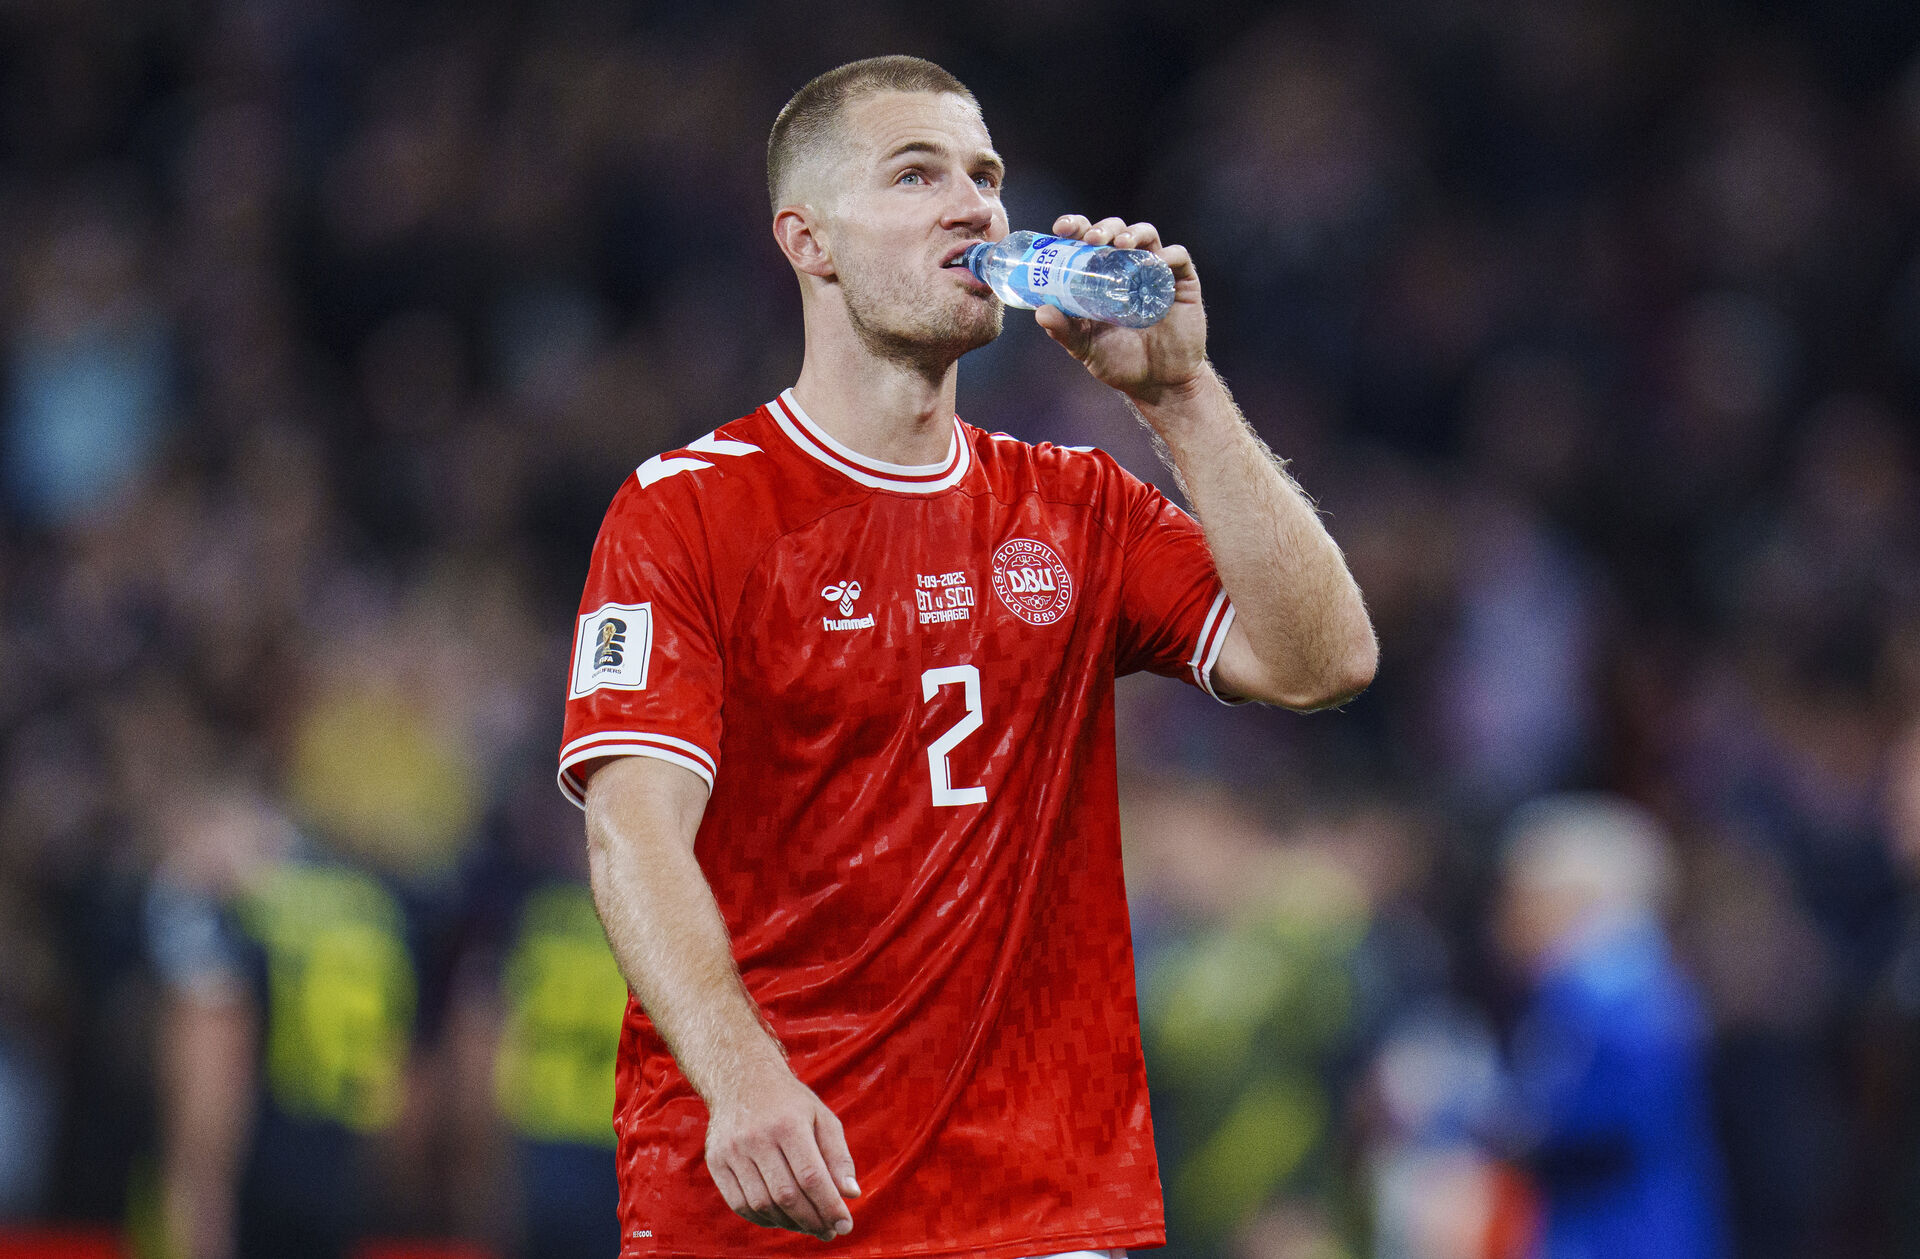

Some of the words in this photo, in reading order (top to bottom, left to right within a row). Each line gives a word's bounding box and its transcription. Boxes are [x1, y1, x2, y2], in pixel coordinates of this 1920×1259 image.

[1033, 248, 1052, 287] KILDE
[993, 565, 1022, 614] DANSK
[1027, 610, 1056, 623] 1889
[1006, 567, 1056, 593] DBU
[945, 586, 975, 608] SCO
[822, 613, 875, 631] hummel
[921, 664, 988, 807] 2
